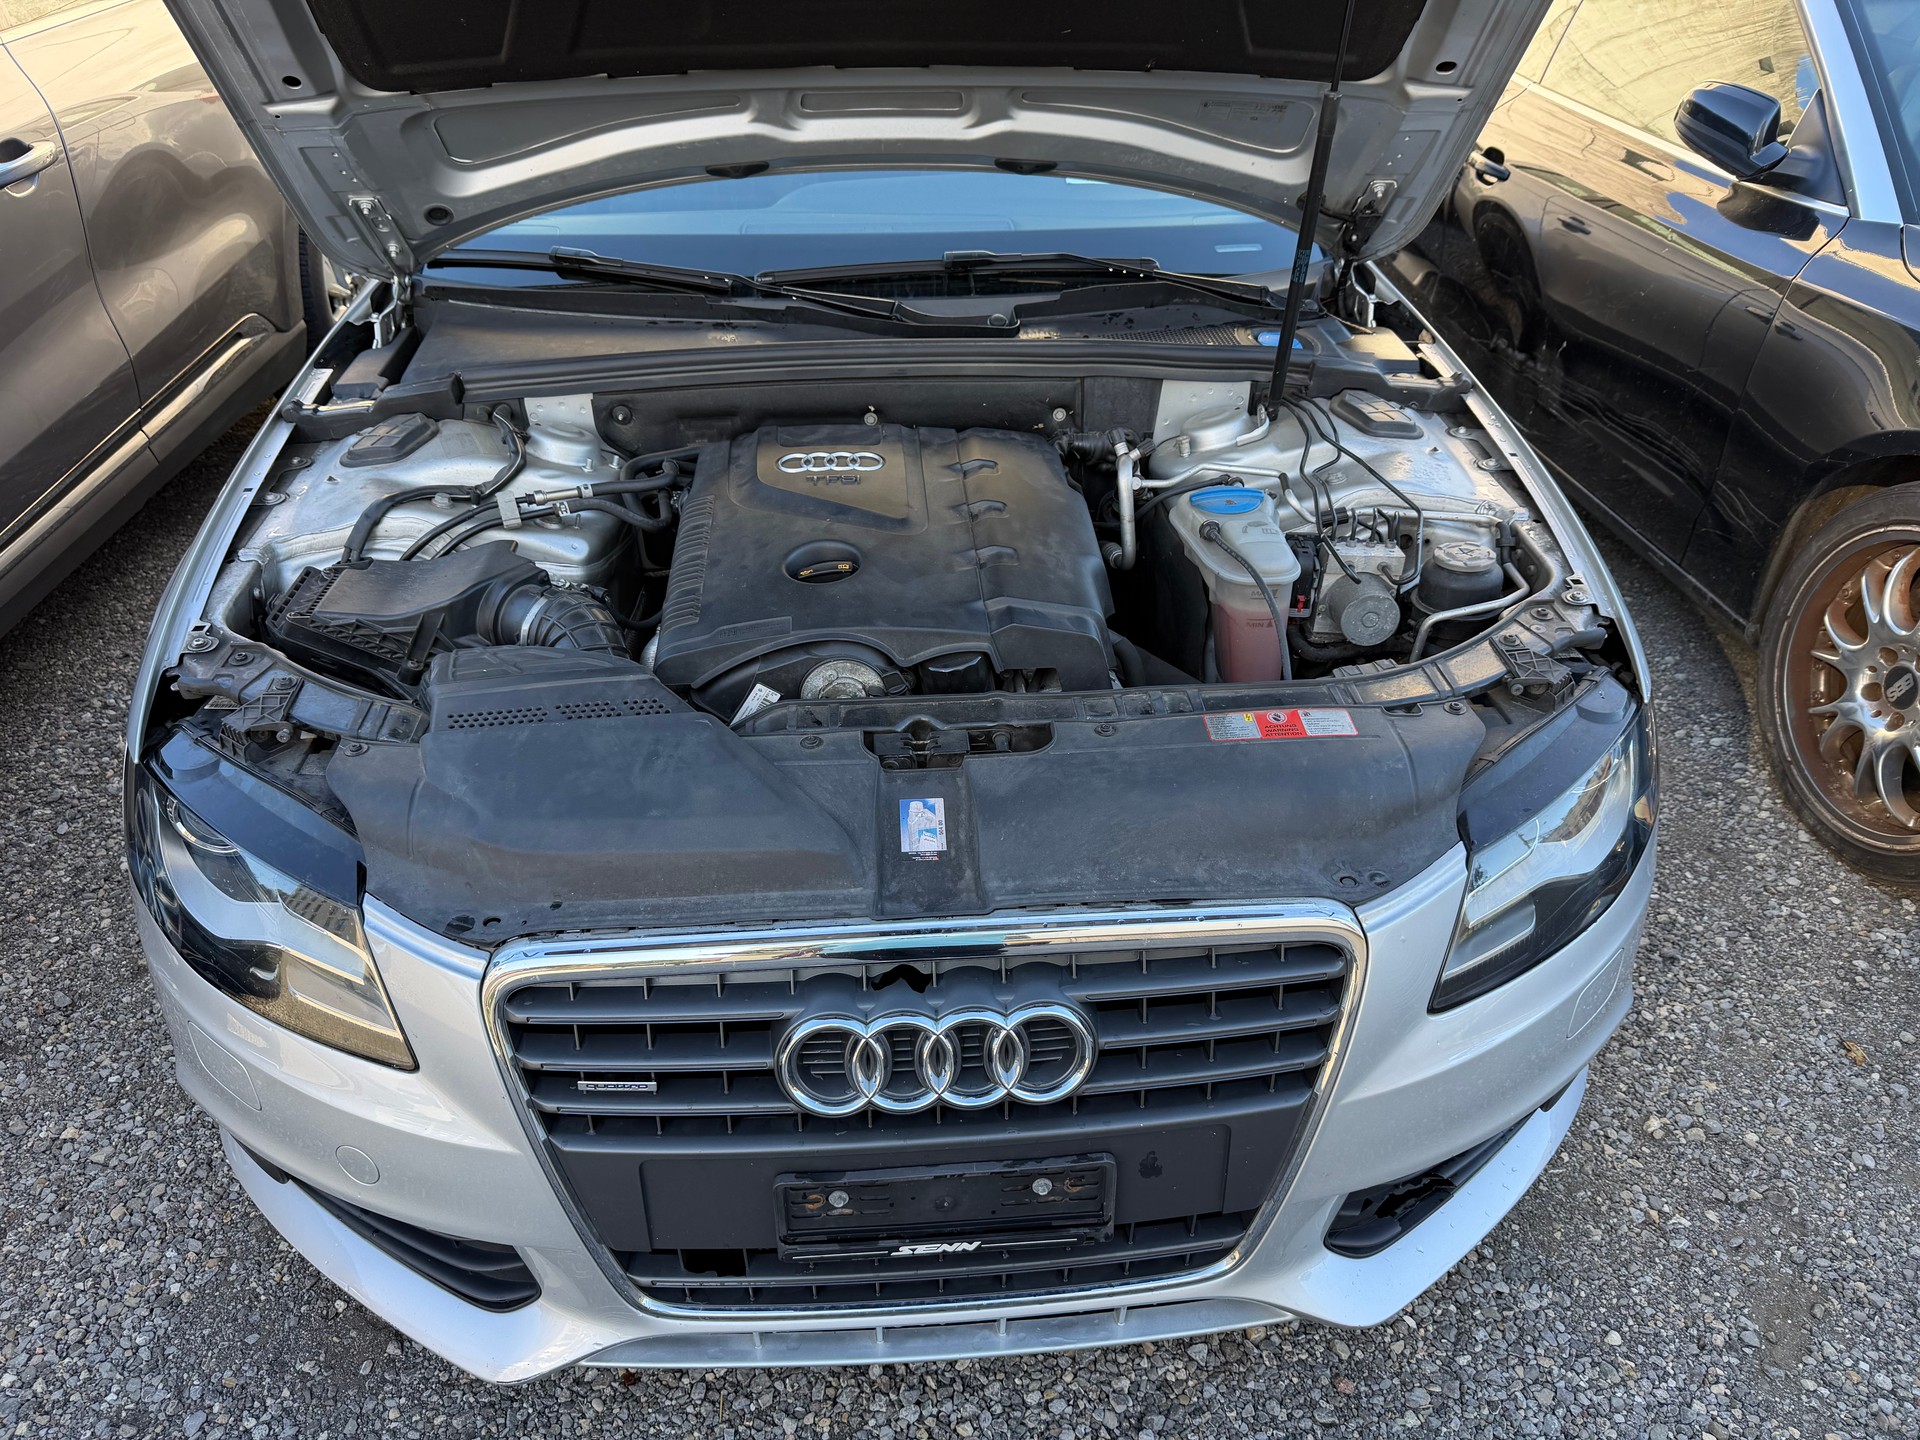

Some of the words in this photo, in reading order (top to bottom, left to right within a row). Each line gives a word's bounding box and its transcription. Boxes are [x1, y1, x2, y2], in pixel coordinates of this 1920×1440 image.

[805, 474, 861, 486] TFSI
[1886, 673, 1914, 702] BBS
[890, 1241, 982, 1255] SENN
